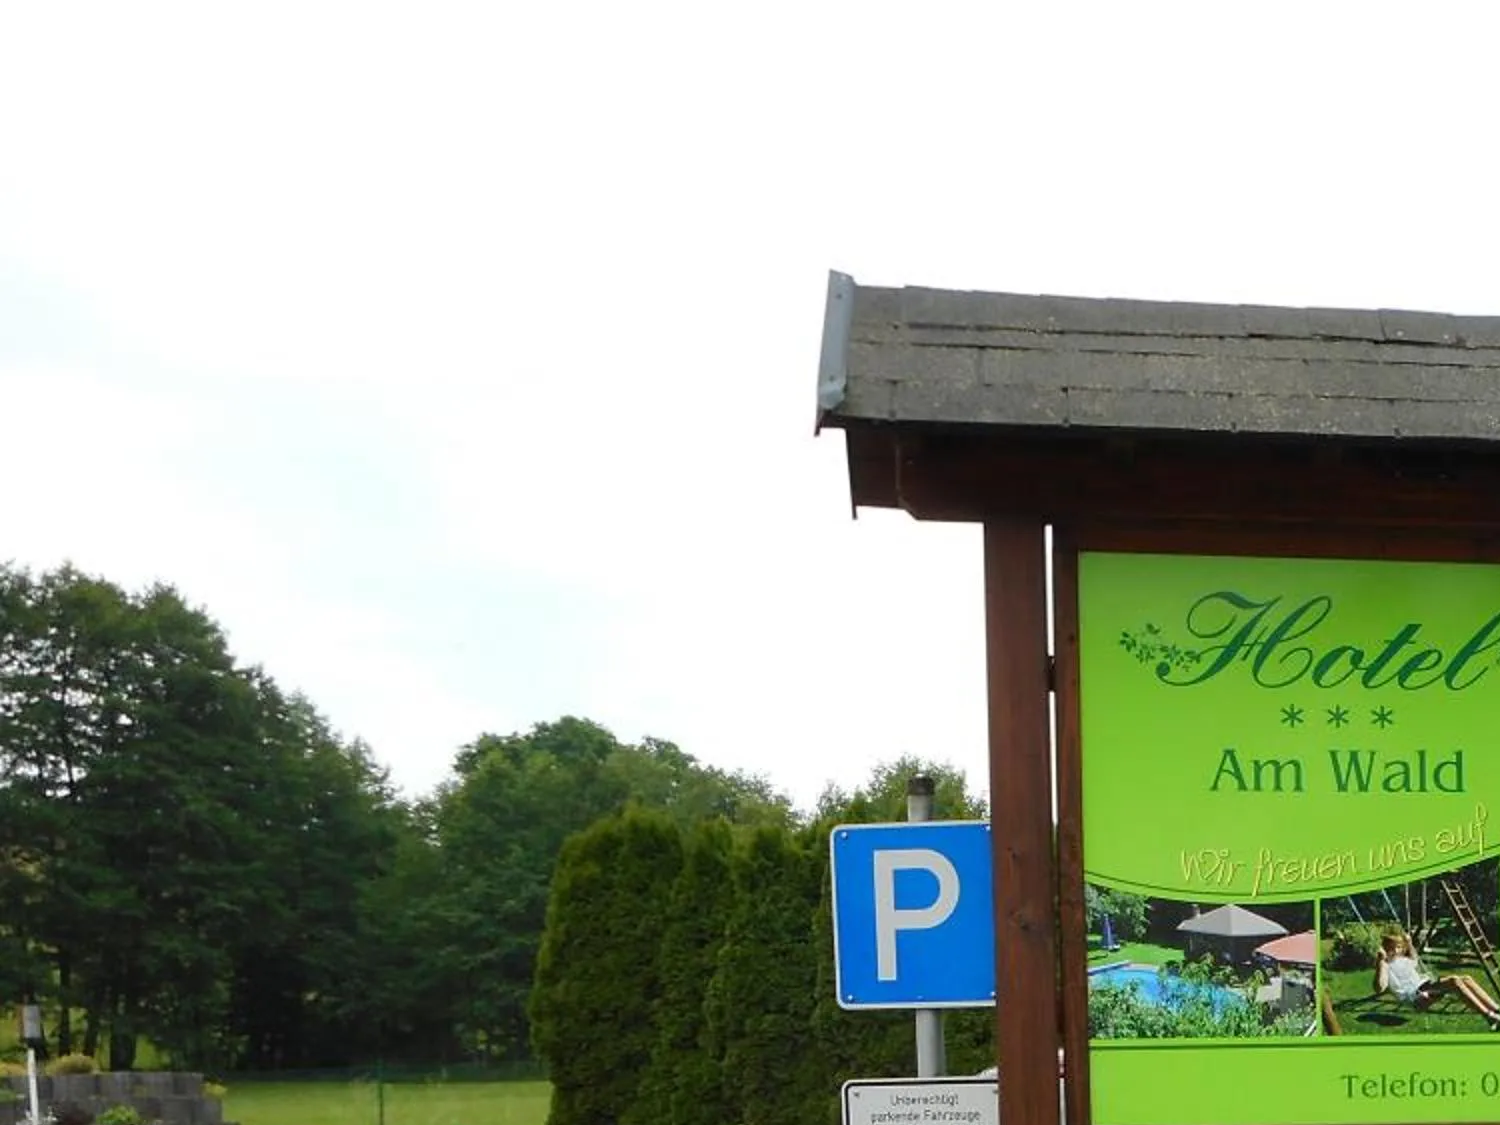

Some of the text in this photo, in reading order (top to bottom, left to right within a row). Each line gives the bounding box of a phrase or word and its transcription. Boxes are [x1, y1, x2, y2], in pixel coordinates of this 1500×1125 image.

[1209, 748, 1465, 793] Am Wald
[1180, 847, 1247, 886] Wir
[1251, 846, 1357, 899] freuen
[1369, 835, 1426, 872] uns
[1433, 801, 1488, 856] auf
[873, 849, 961, 982] P
[1340, 1072, 1468, 1099] Telefon:
[923, 1109, 982, 1122] Fahrzeuge
